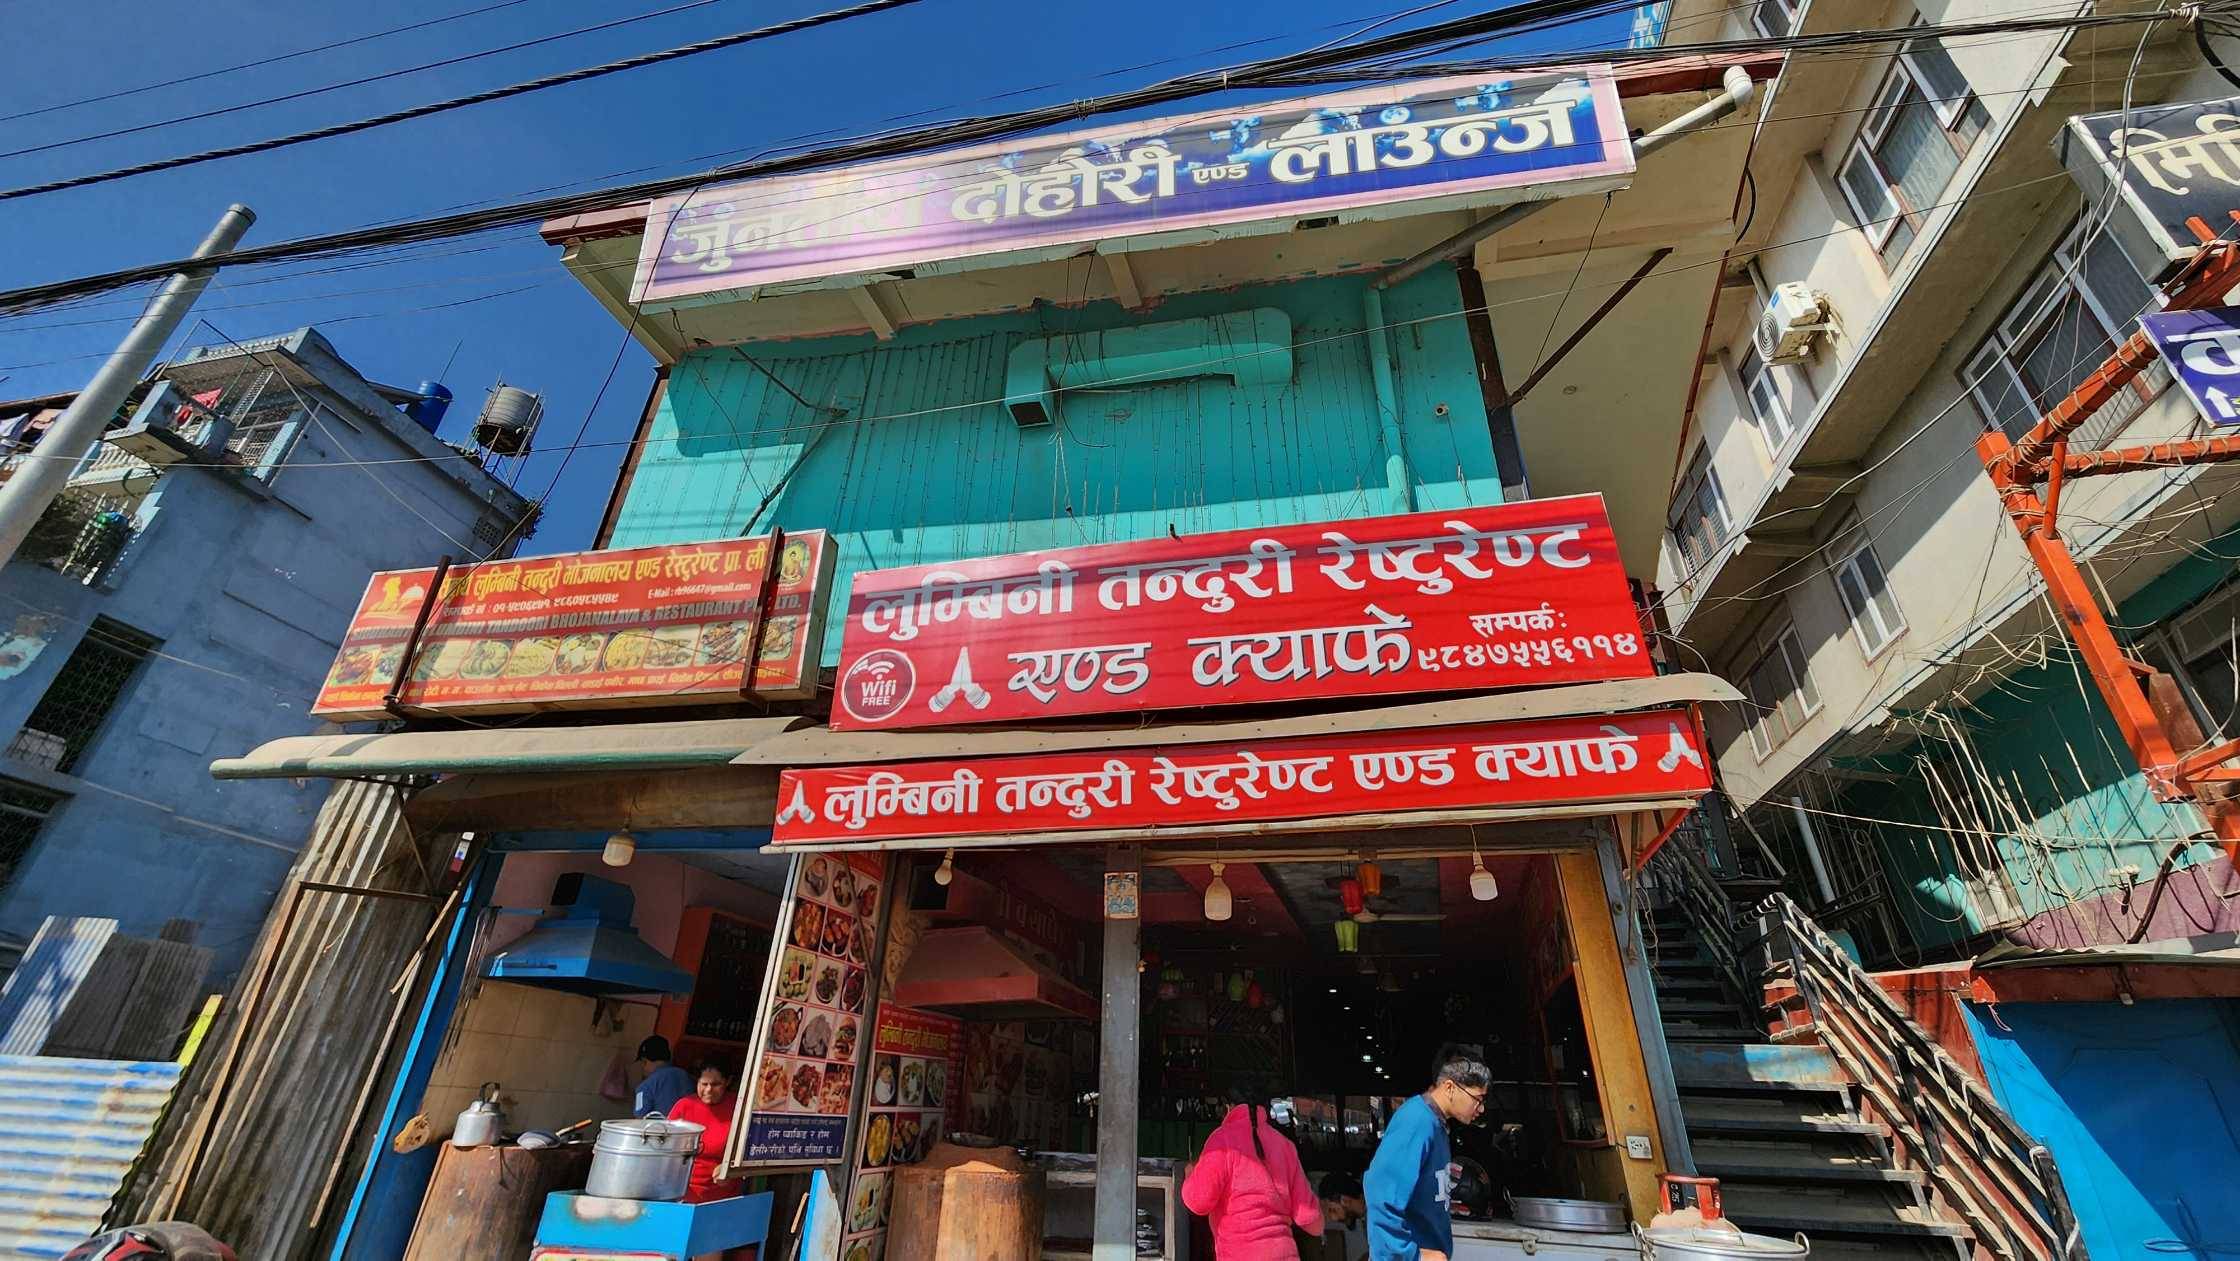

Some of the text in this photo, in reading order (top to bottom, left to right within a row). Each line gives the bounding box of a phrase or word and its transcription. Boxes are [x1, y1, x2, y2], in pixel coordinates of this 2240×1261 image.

[1191, 162, 1249, 184] एण्ड
[635, 556, 661, 581] एण्ड
[861, 520, 1592, 641] लुम्बिनी तन्दुरी रेष्टुरेण्ट
[654, 600, 742, 620] RESTAURANT
[1008, 603, 1414, 704] एण्ड क्याफे
[1417, 632, 1638, 672] ९८४७५५६११४
[861, 674, 896, 697] Wifi
[862, 696, 891, 707] FREE
[823, 725, 1639, 830] लुम्बिनी तन्दुरी रेष्टुरेण्ट एण्ड क्याफे
